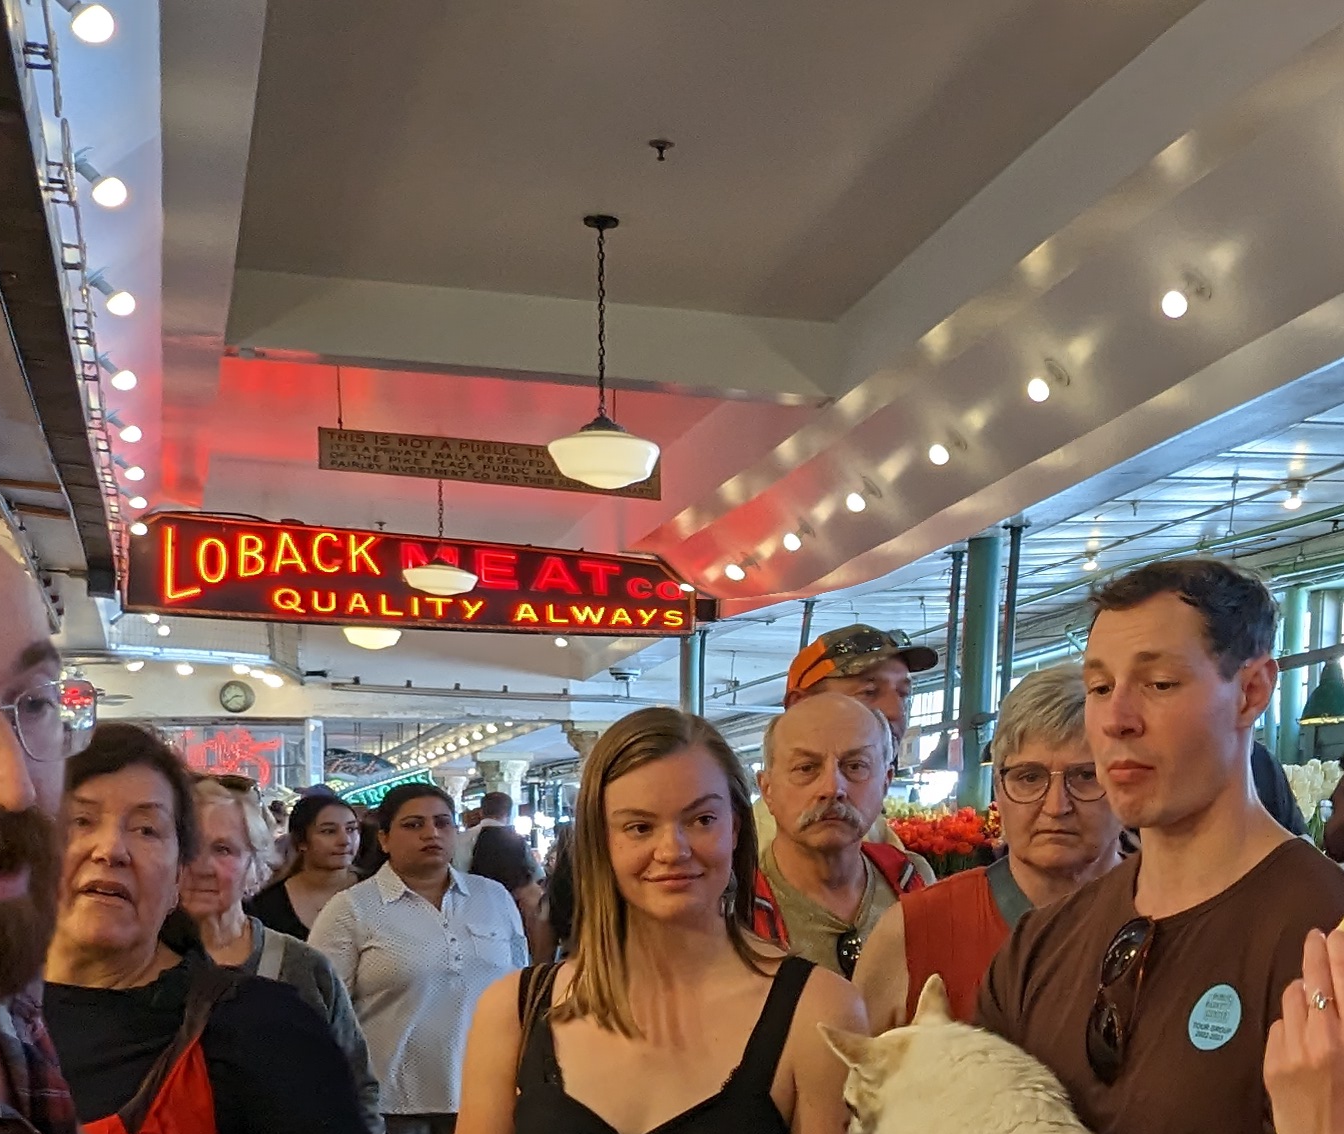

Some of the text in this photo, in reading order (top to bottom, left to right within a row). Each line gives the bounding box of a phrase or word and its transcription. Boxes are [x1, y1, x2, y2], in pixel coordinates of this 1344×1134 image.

[327, 431, 365, 443] THIS
[375, 435, 390, 445] IS
[398, 437, 433, 449] NOT
[440, 440, 452, 450] A
[459, 442, 518, 456] PUBLIC
[163, 523, 382, 603] LOBACK
[399, 540, 623, 594] MEAT
[272, 586, 686, 628] QUALITY ALWAYS
